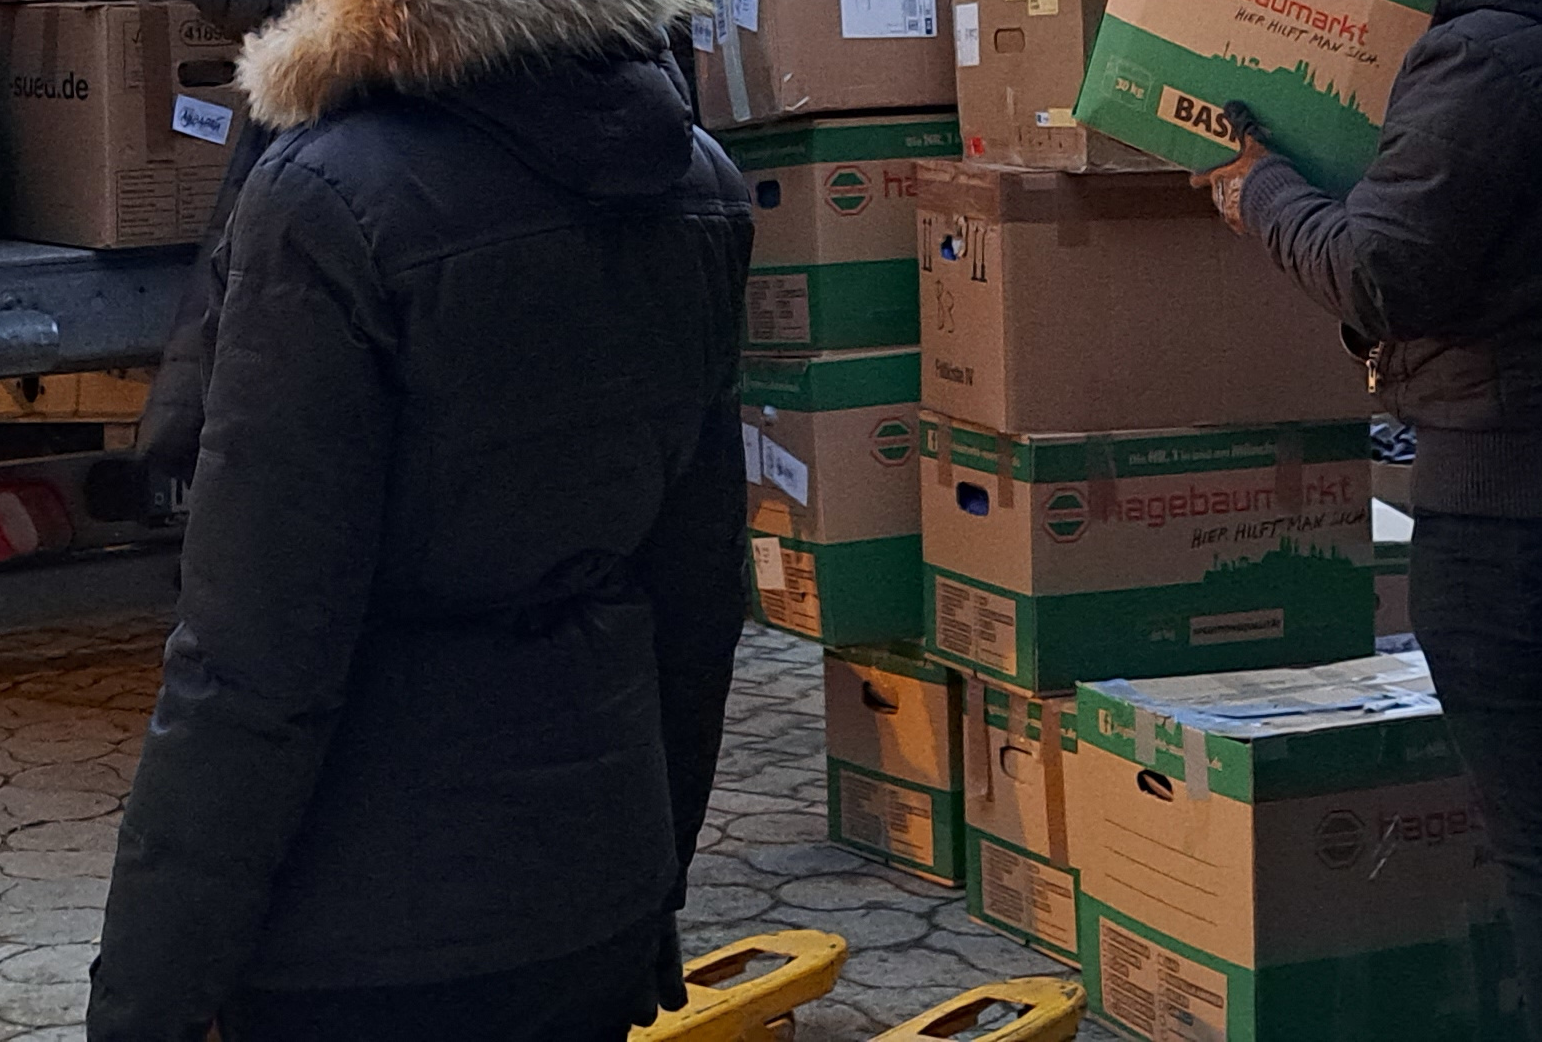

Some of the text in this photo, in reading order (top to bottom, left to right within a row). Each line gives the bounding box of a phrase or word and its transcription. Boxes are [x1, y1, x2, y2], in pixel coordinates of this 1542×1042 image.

[1234, 6, 1264, 26] HIER
[1267, 20, 1307, 42] HILFT
[1311, 32, 1344, 52] MAN
[1174, 95, 1237, 143] BAS
[1106, 475, 1351, 528] hagebaumrkt
[1190, 527, 1229, 550] HIER
[1233, 516, 1284, 542] HILFT
[1287, 514, 1325, 532] MAN
